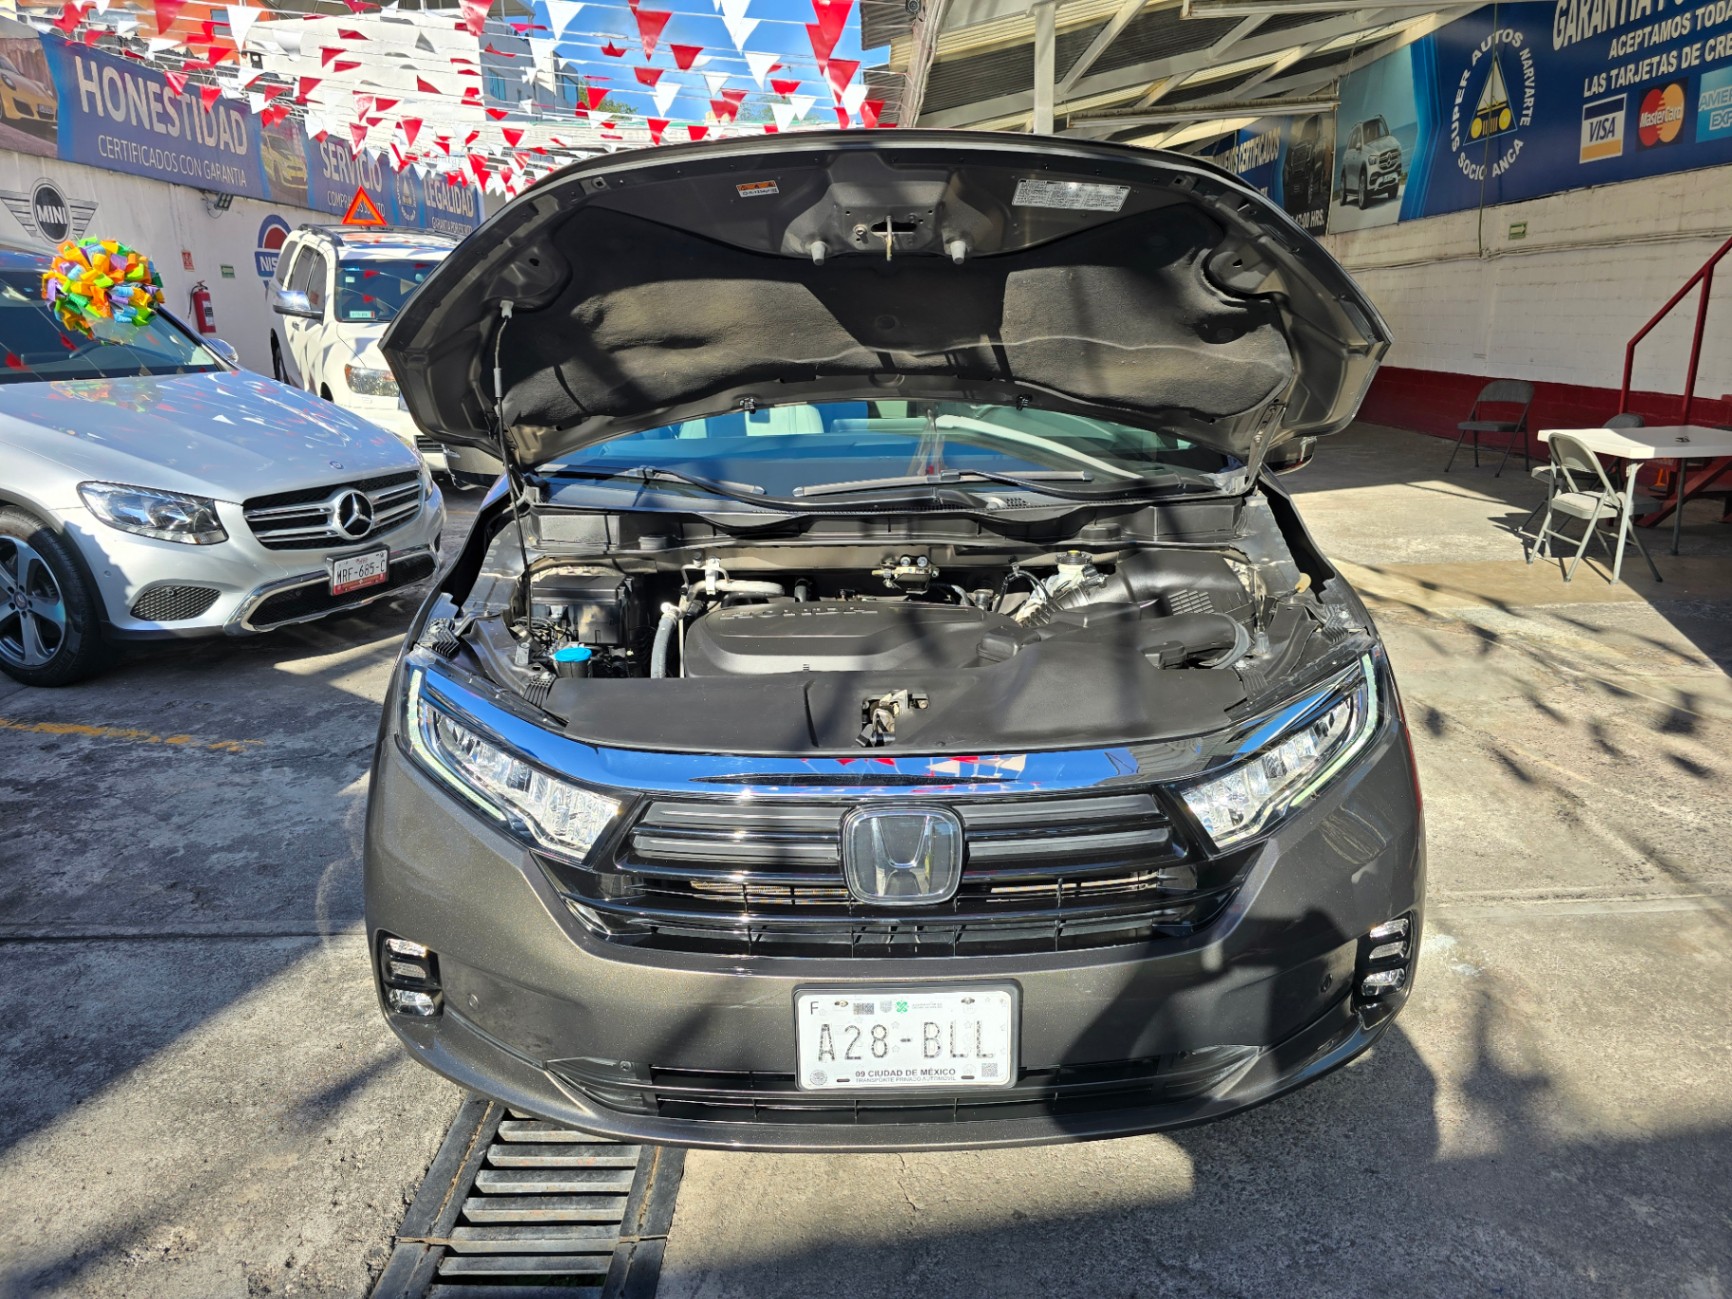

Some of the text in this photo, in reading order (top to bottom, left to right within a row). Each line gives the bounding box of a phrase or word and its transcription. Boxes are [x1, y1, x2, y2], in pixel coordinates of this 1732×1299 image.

[1608, 13, 1691, 60] ACEPTAMOS
[1451, 28, 1535, 152] SUPER AUTOS NARVARTE
[1584, 72, 1606, 98] LAS
[1610, 50, 1678, 90] TARJETAS
[1681, 42, 1701, 70] DE
[75, 56, 248, 156] HONESTIDAD
[1590, 116, 1616, 143] VISA
[98, 135, 247, 187] CERTIFICADOS CON GARANTIA
[320, 142, 383, 193] SERVICIO
[1458, 139, 1524, 181] SOCIO ANCA
[36, 204, 68, 225] MINI
[423, 178, 474, 218] LEGALIDAD
[810, 1001, 819, 1015] F
[818, 1020, 995, 1062] A28-BLL
[855, 1067, 956, 1078] 09 CIUDAD DE MÉXICO
